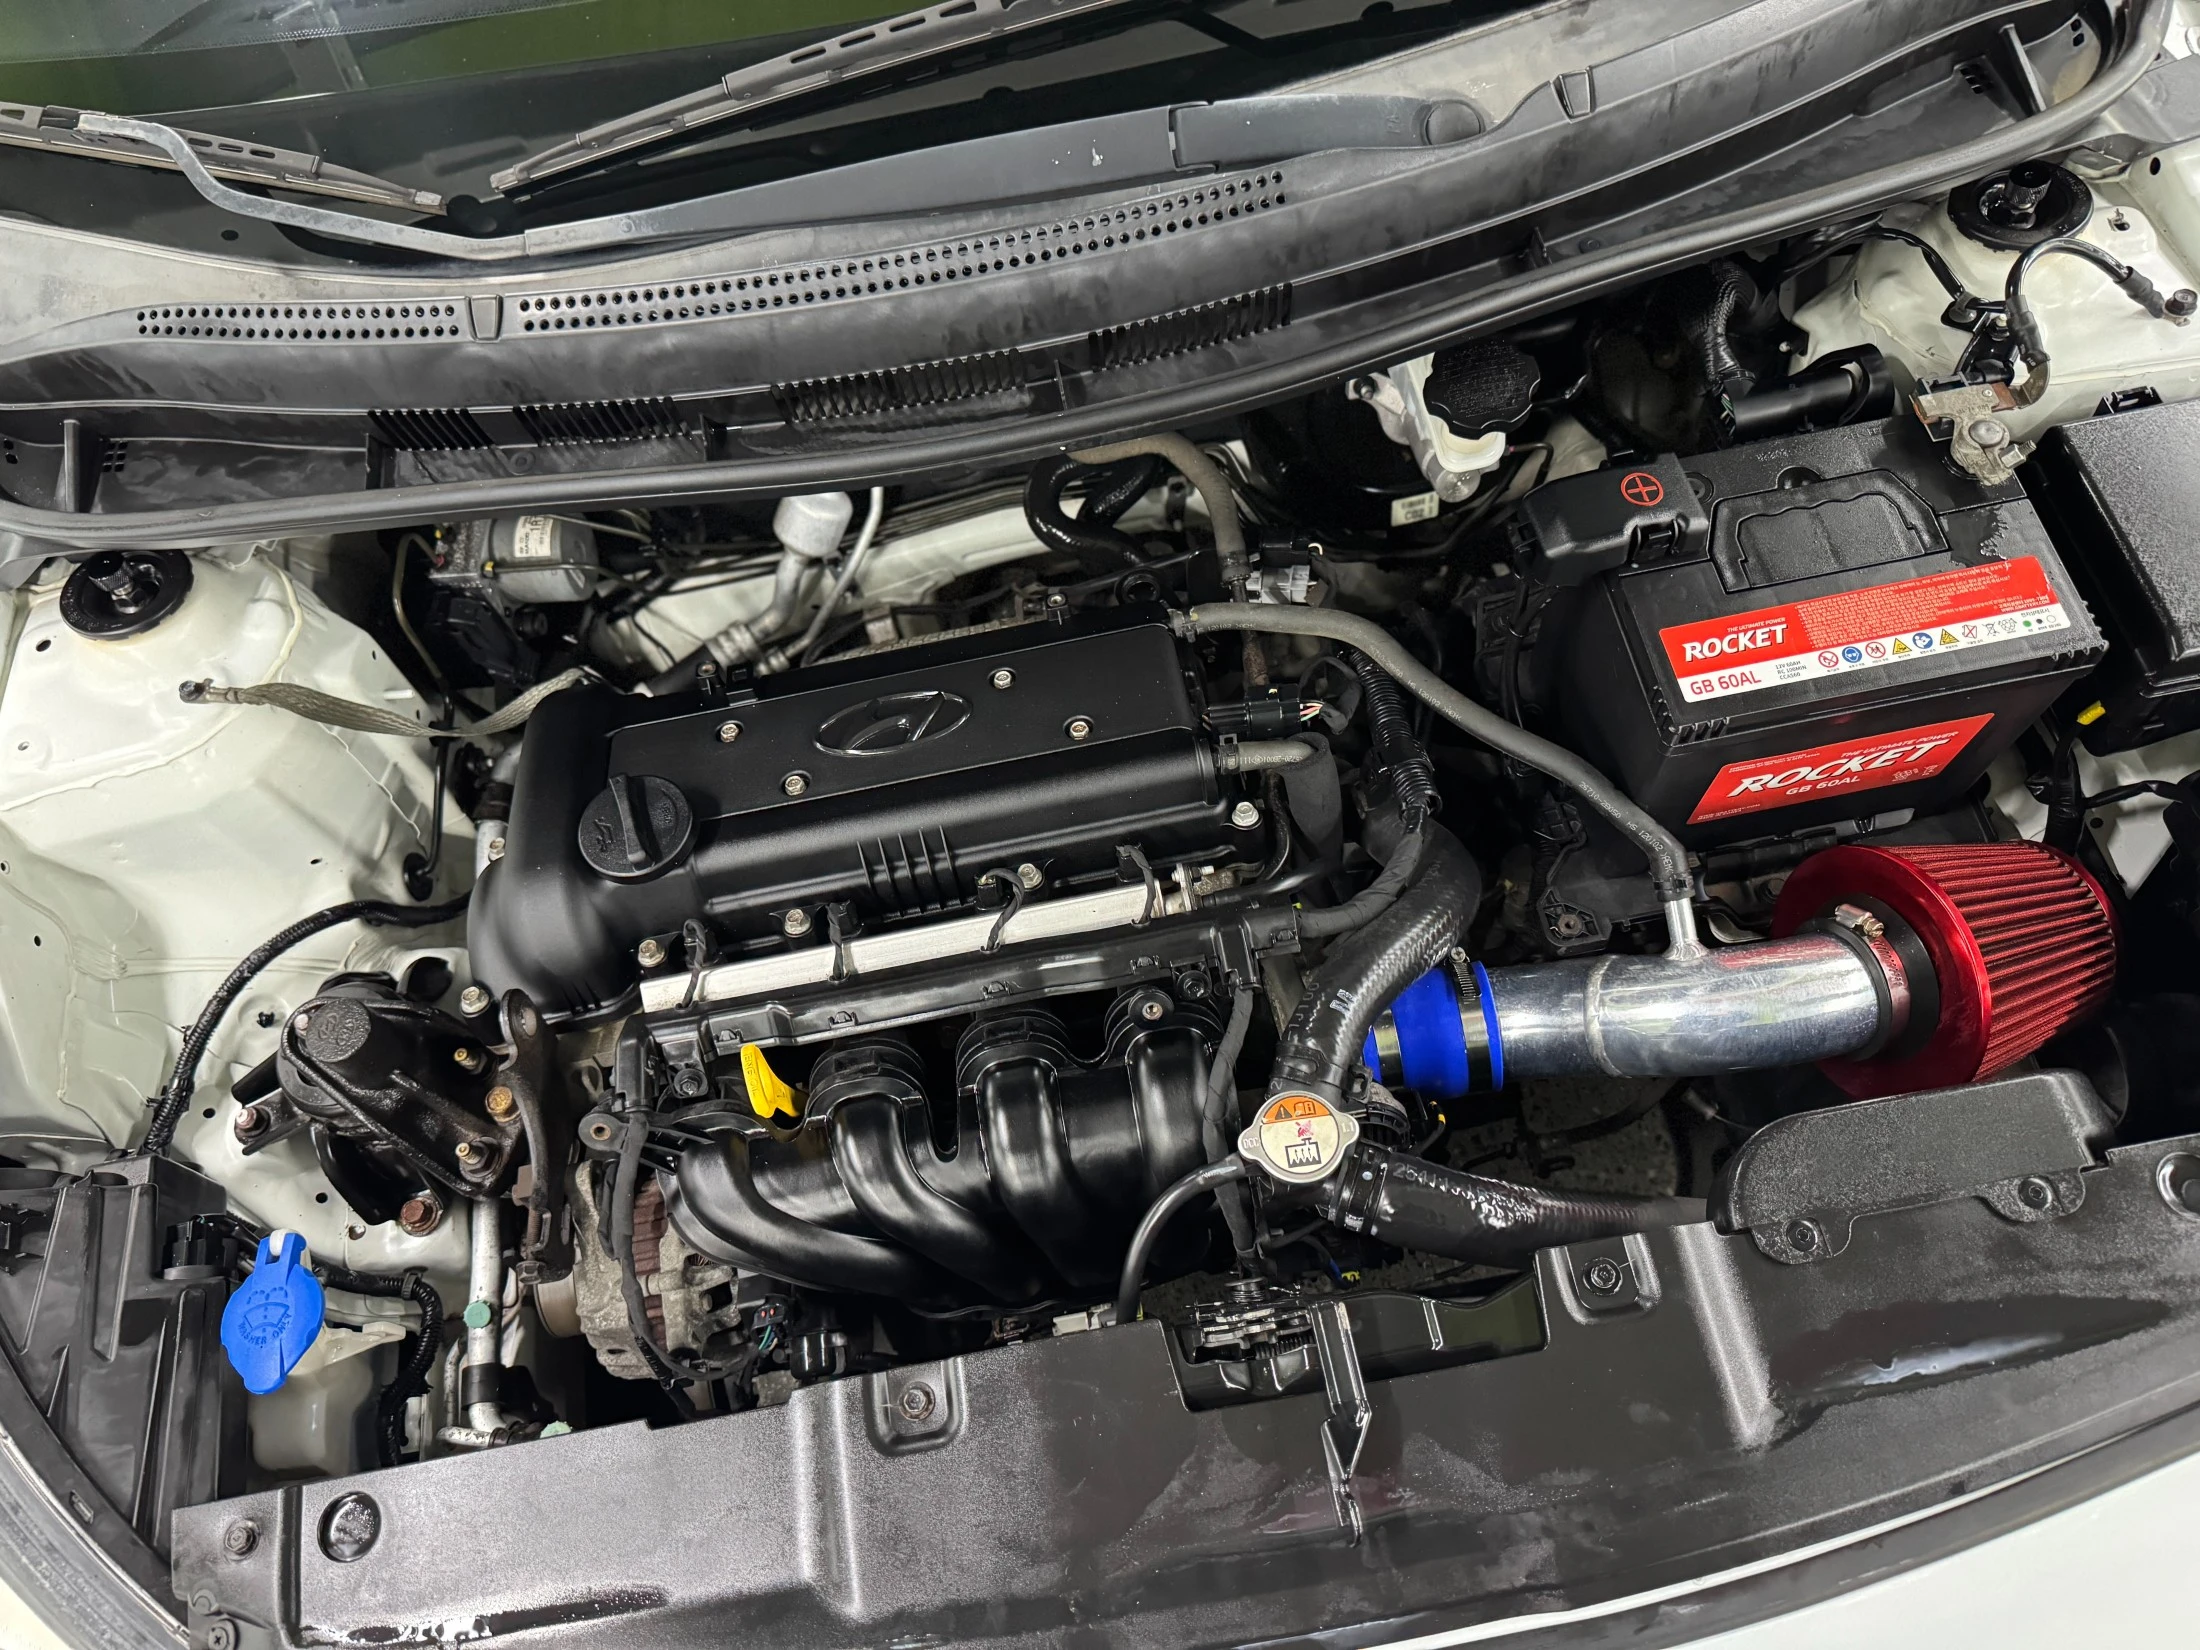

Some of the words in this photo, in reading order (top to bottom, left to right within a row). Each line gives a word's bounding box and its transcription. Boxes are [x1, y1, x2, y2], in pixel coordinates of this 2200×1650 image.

[1738, 620, 1765, 631] ULTIMATE
[1765, 616, 1786, 625] POWER
[1682, 623, 1788, 662] ROCKET
[1690, 679, 1715, 695] GB
[1718, 670, 1762, 690] 60AL
[1841, 749, 1862, 759] THE
[1863, 740, 1915, 755] ULTIMATE
[1915, 731, 1959, 746] POWER
[1727, 740, 1950, 798] ROCKET
[1786, 784, 1811, 795] GB
[1816, 775, 1861, 789] 60AL
[744, 1053, 756, 1075] ENG
[749, 1079, 759, 1097] OIL
[238, 1320, 267, 1345] WASHER
